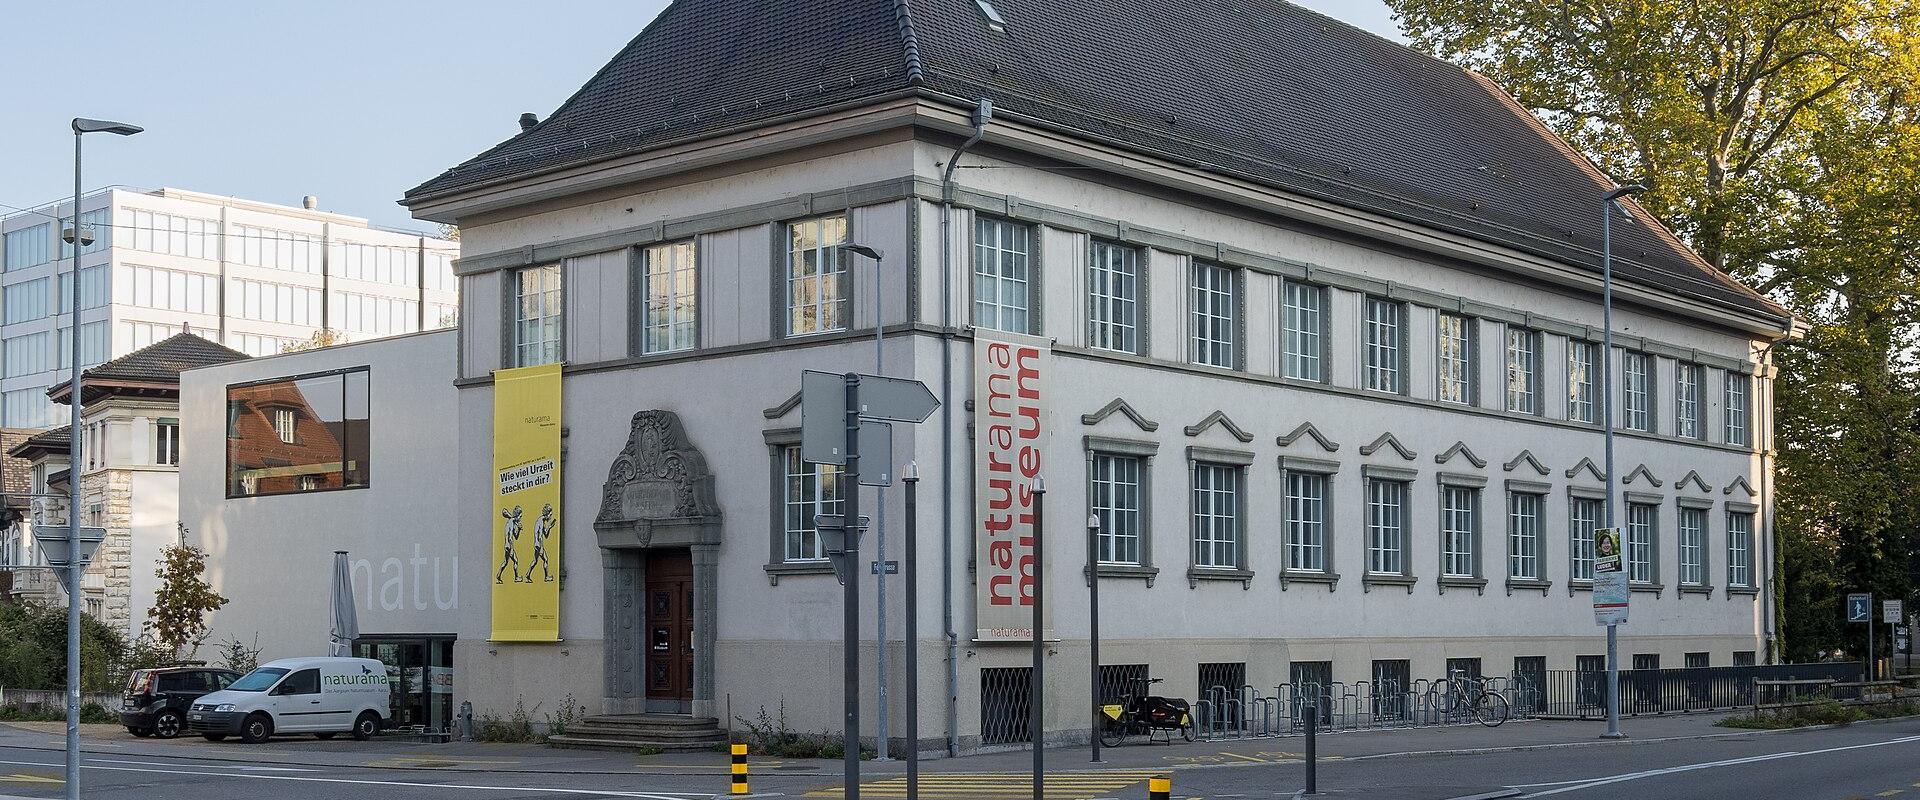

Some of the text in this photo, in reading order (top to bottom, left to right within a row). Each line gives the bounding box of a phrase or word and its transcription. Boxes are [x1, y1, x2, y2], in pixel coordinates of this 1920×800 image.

[524, 415, 550, 424] naturama
[500, 472, 515, 483] Wie
[515, 467, 529, 479] viel
[530, 460, 554, 475] Urzeit
[985, 343, 1012, 606] naturama
[1016, 346, 1041, 606] museum
[501, 473, 550, 495] steckt in dir?
[350, 543, 459, 612] natu
[991, 627, 1031, 638] naturama
[324, 674, 387, 685] naturama
